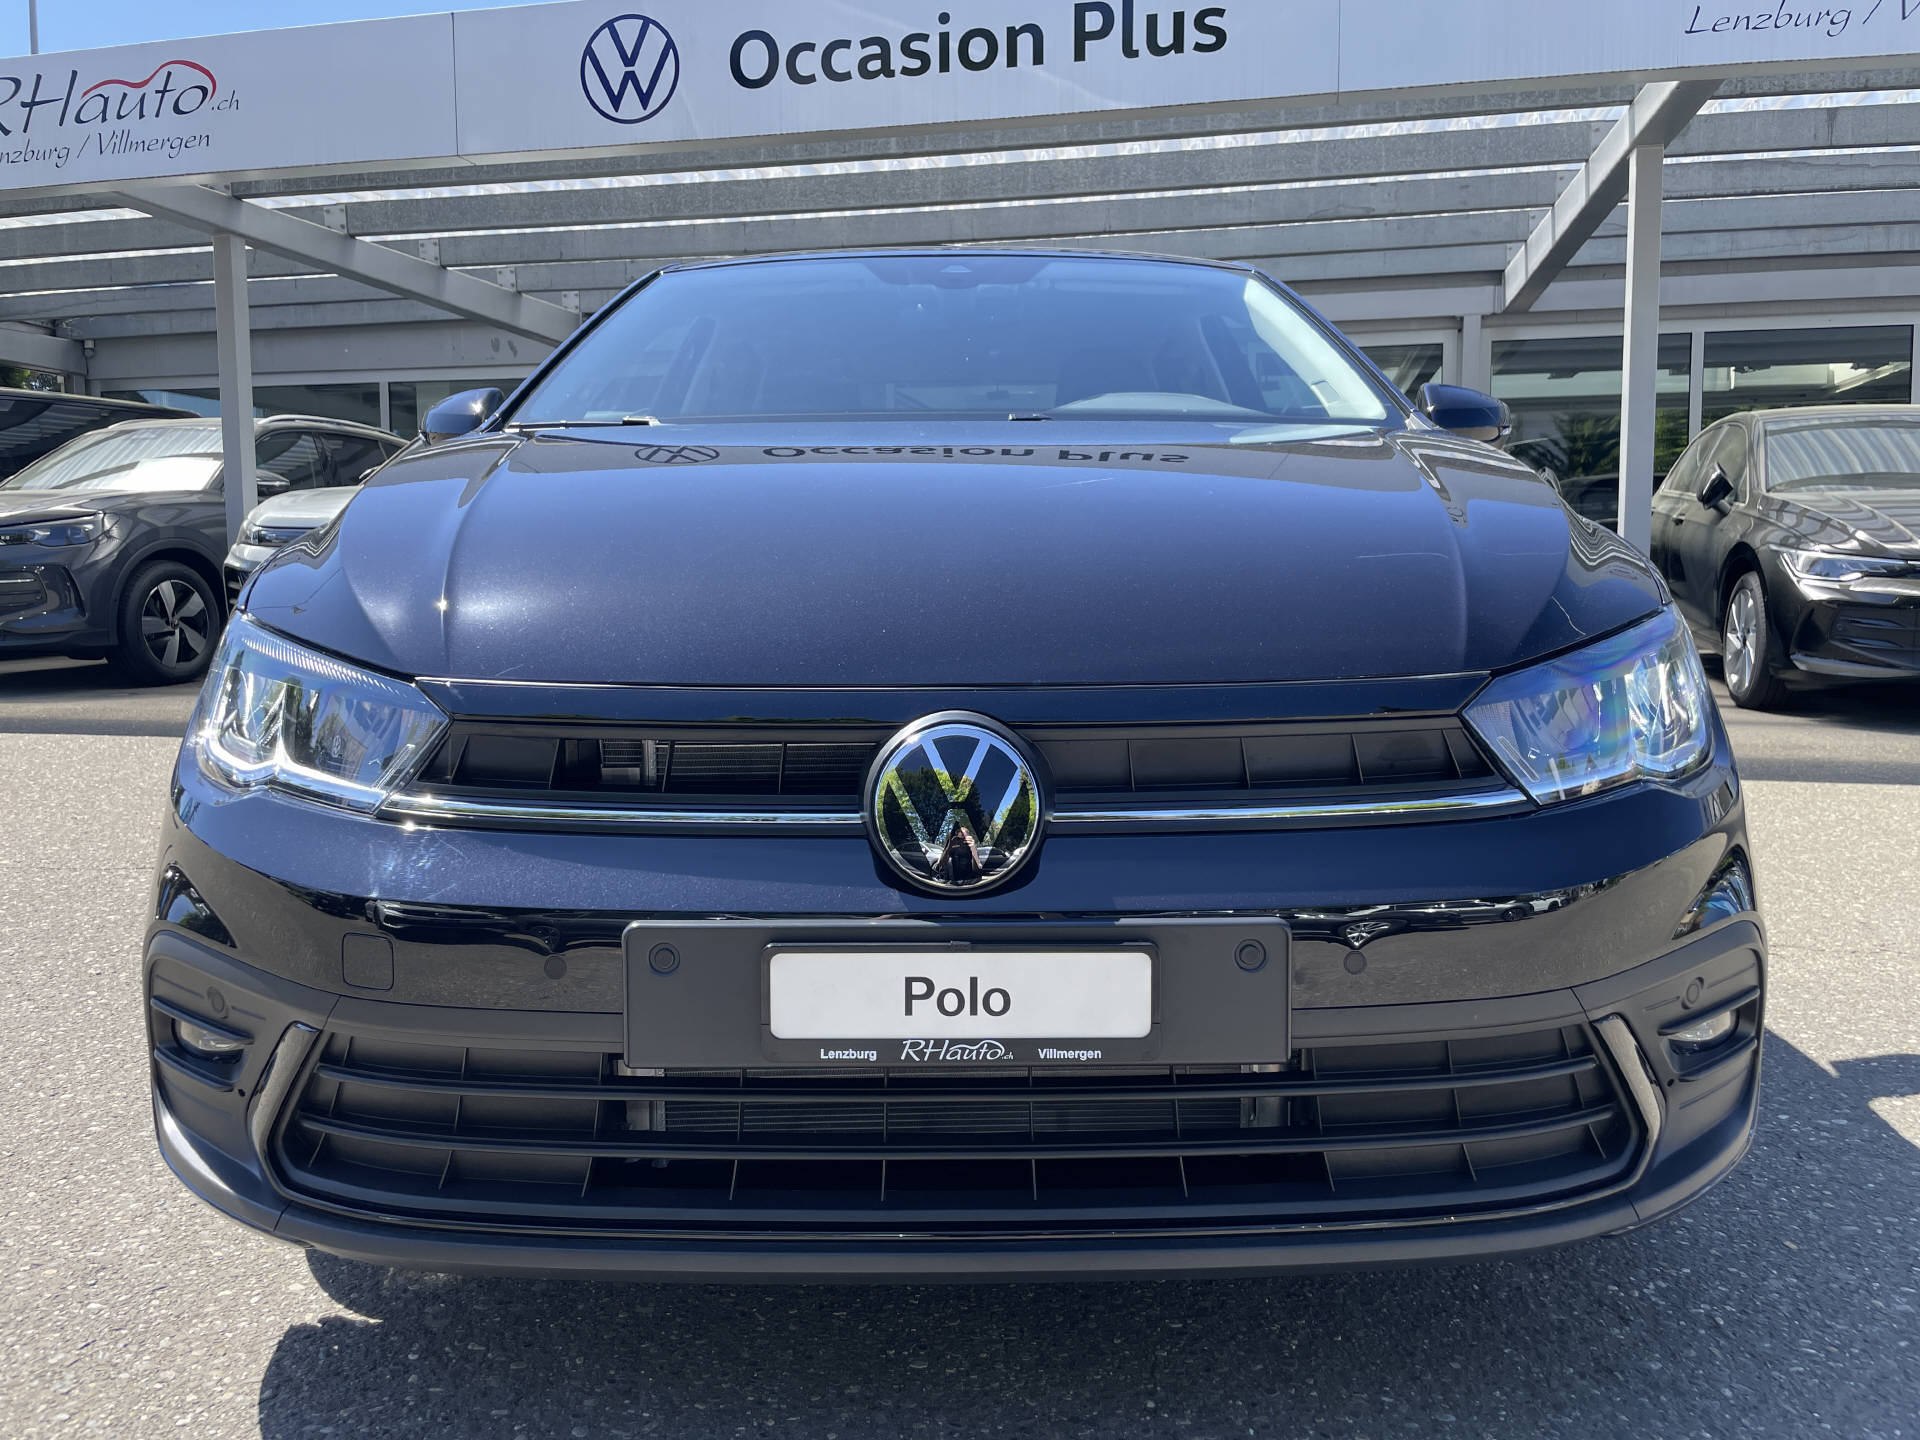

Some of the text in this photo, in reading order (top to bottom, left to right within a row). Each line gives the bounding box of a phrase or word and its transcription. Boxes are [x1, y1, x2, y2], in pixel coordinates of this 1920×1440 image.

[1685, 0, 1851, 37] Lenzburg
[729, 0, 1227, 89] Occasion Plus
[77, 131, 90, 159] /
[98, 130, 210, 160] Villmergen
[903, 976, 1012, 1017] Polo
[820, 1048, 877, 1061] Lenzburg
[1038, 1048, 1102, 1061] Villmergen
